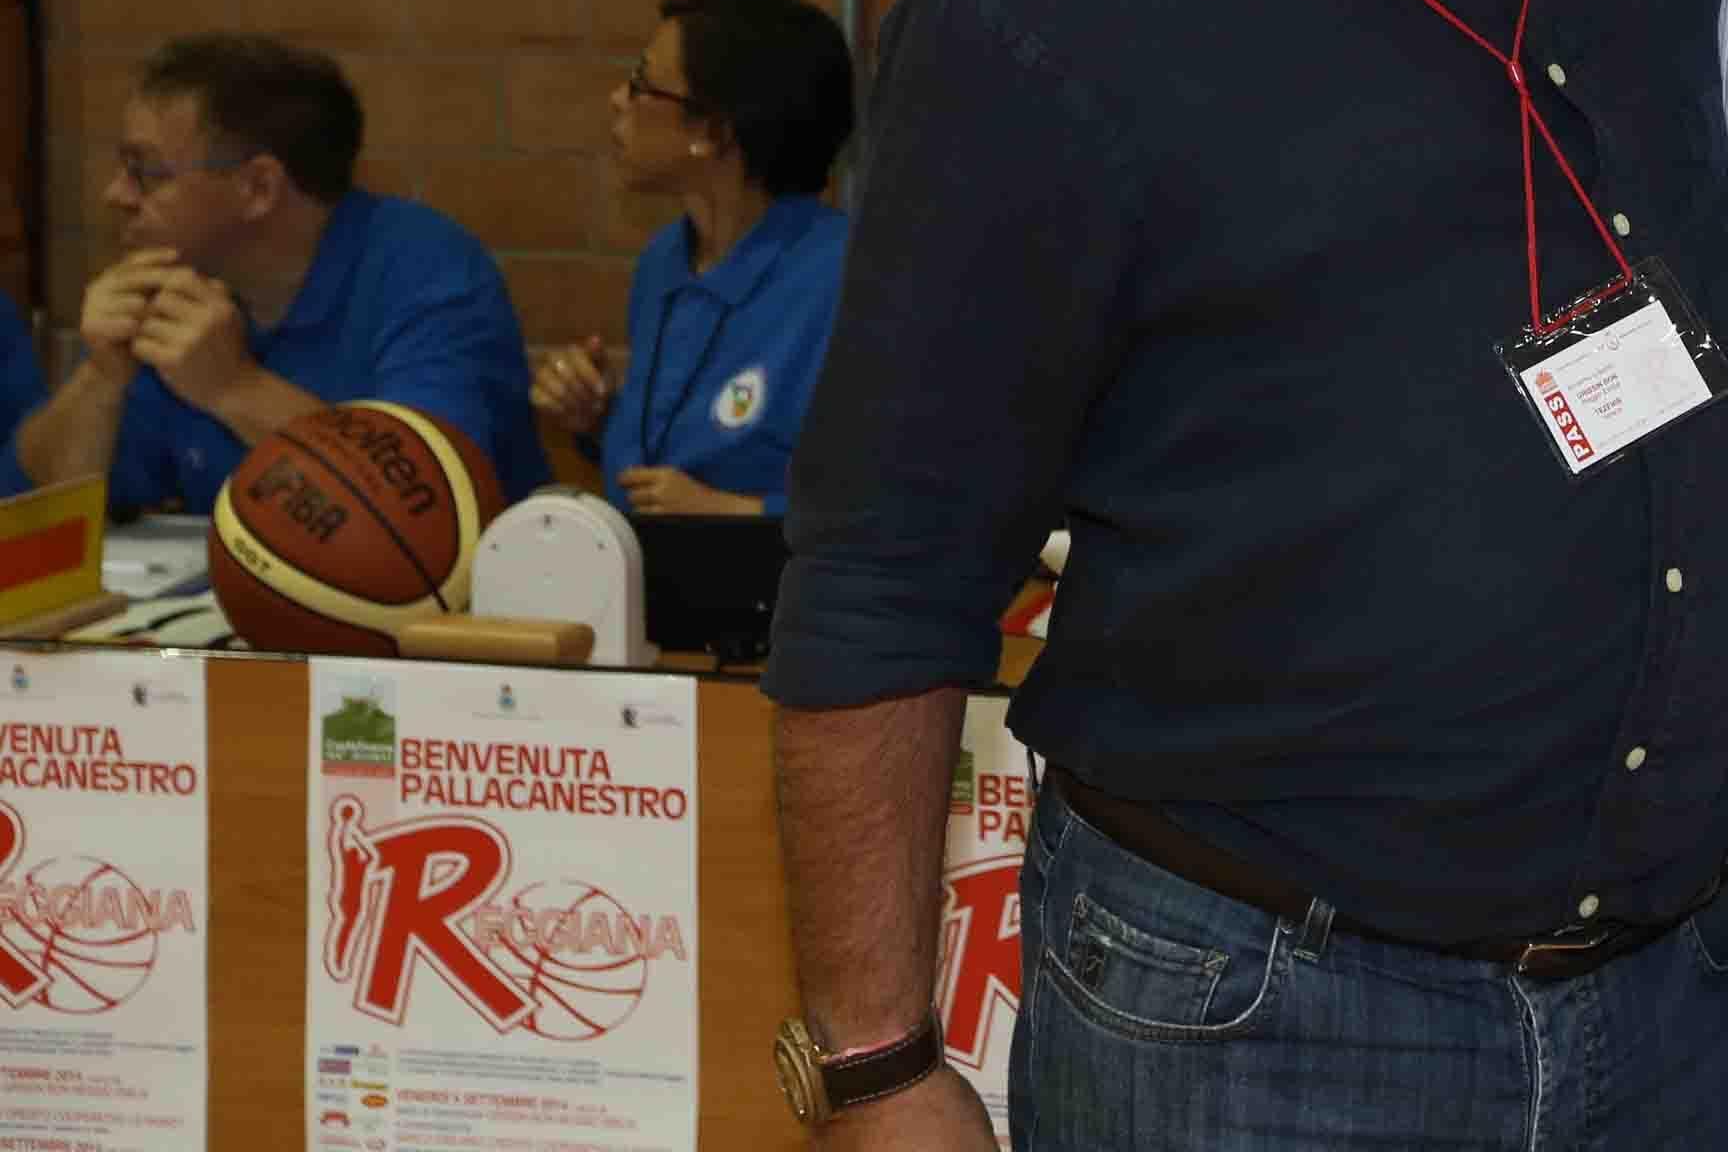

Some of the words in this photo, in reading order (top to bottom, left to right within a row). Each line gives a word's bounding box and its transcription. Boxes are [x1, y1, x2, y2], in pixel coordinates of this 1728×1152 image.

[1548, 394, 1591, 460] PASS
[400, 738, 611, 780] BENVENUTA
[400, 773, 688, 821] PALLACANESTRO
